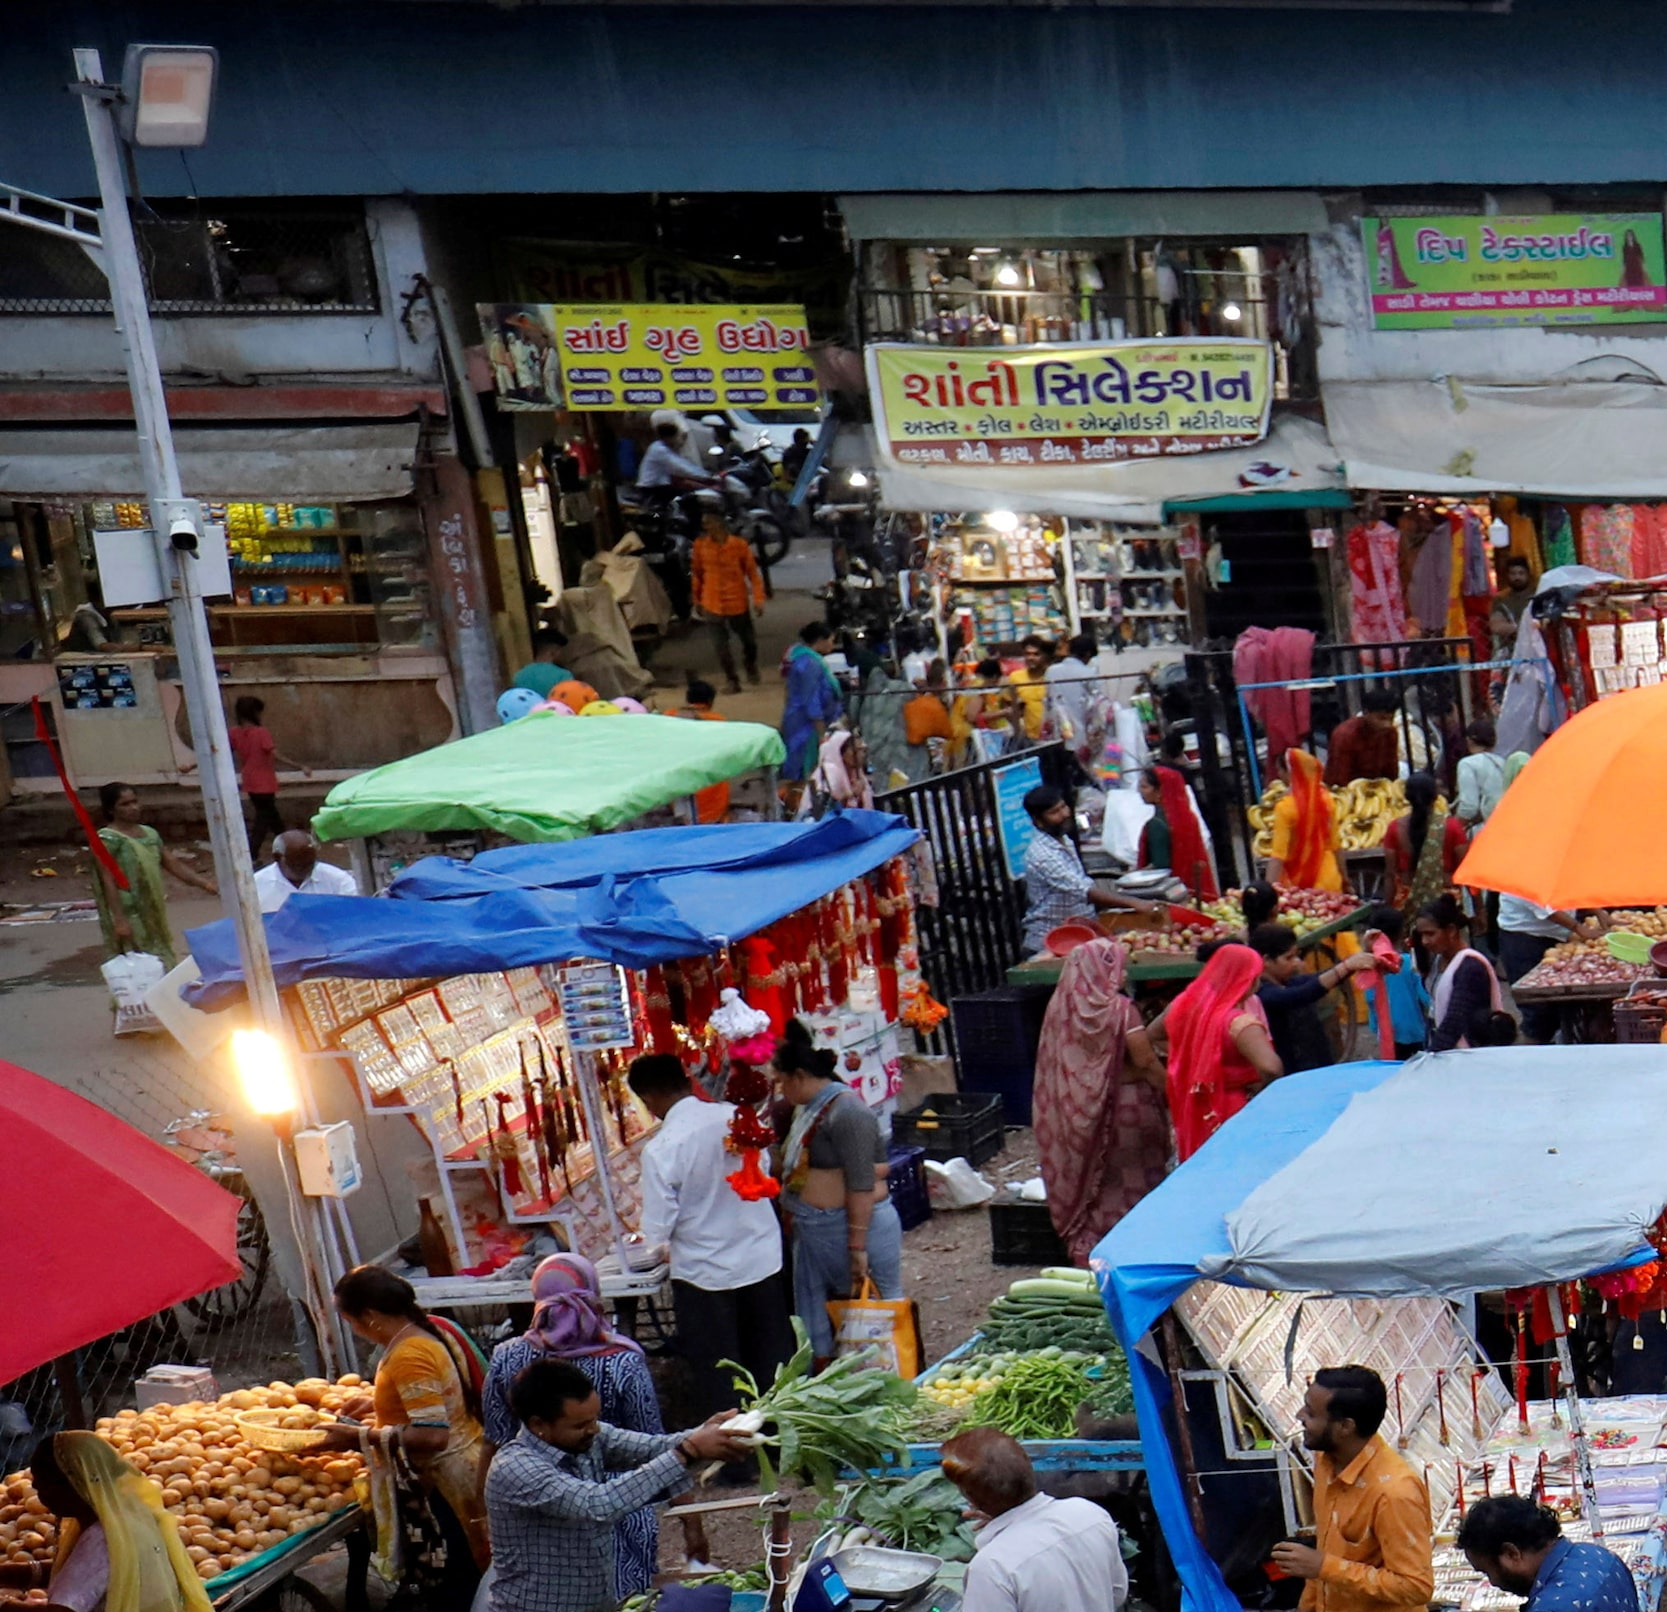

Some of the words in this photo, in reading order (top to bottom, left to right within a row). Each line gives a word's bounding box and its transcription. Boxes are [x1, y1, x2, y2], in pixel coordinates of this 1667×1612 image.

[1416, 227, 1467, 262] દિપ
[564, 319, 630, 352] સાંઈ
[645, 325, 701, 362] ગૃહ
[903, 420, 959, 436] અસ્તર
[1029, 412, 1060, 433] લેશ
